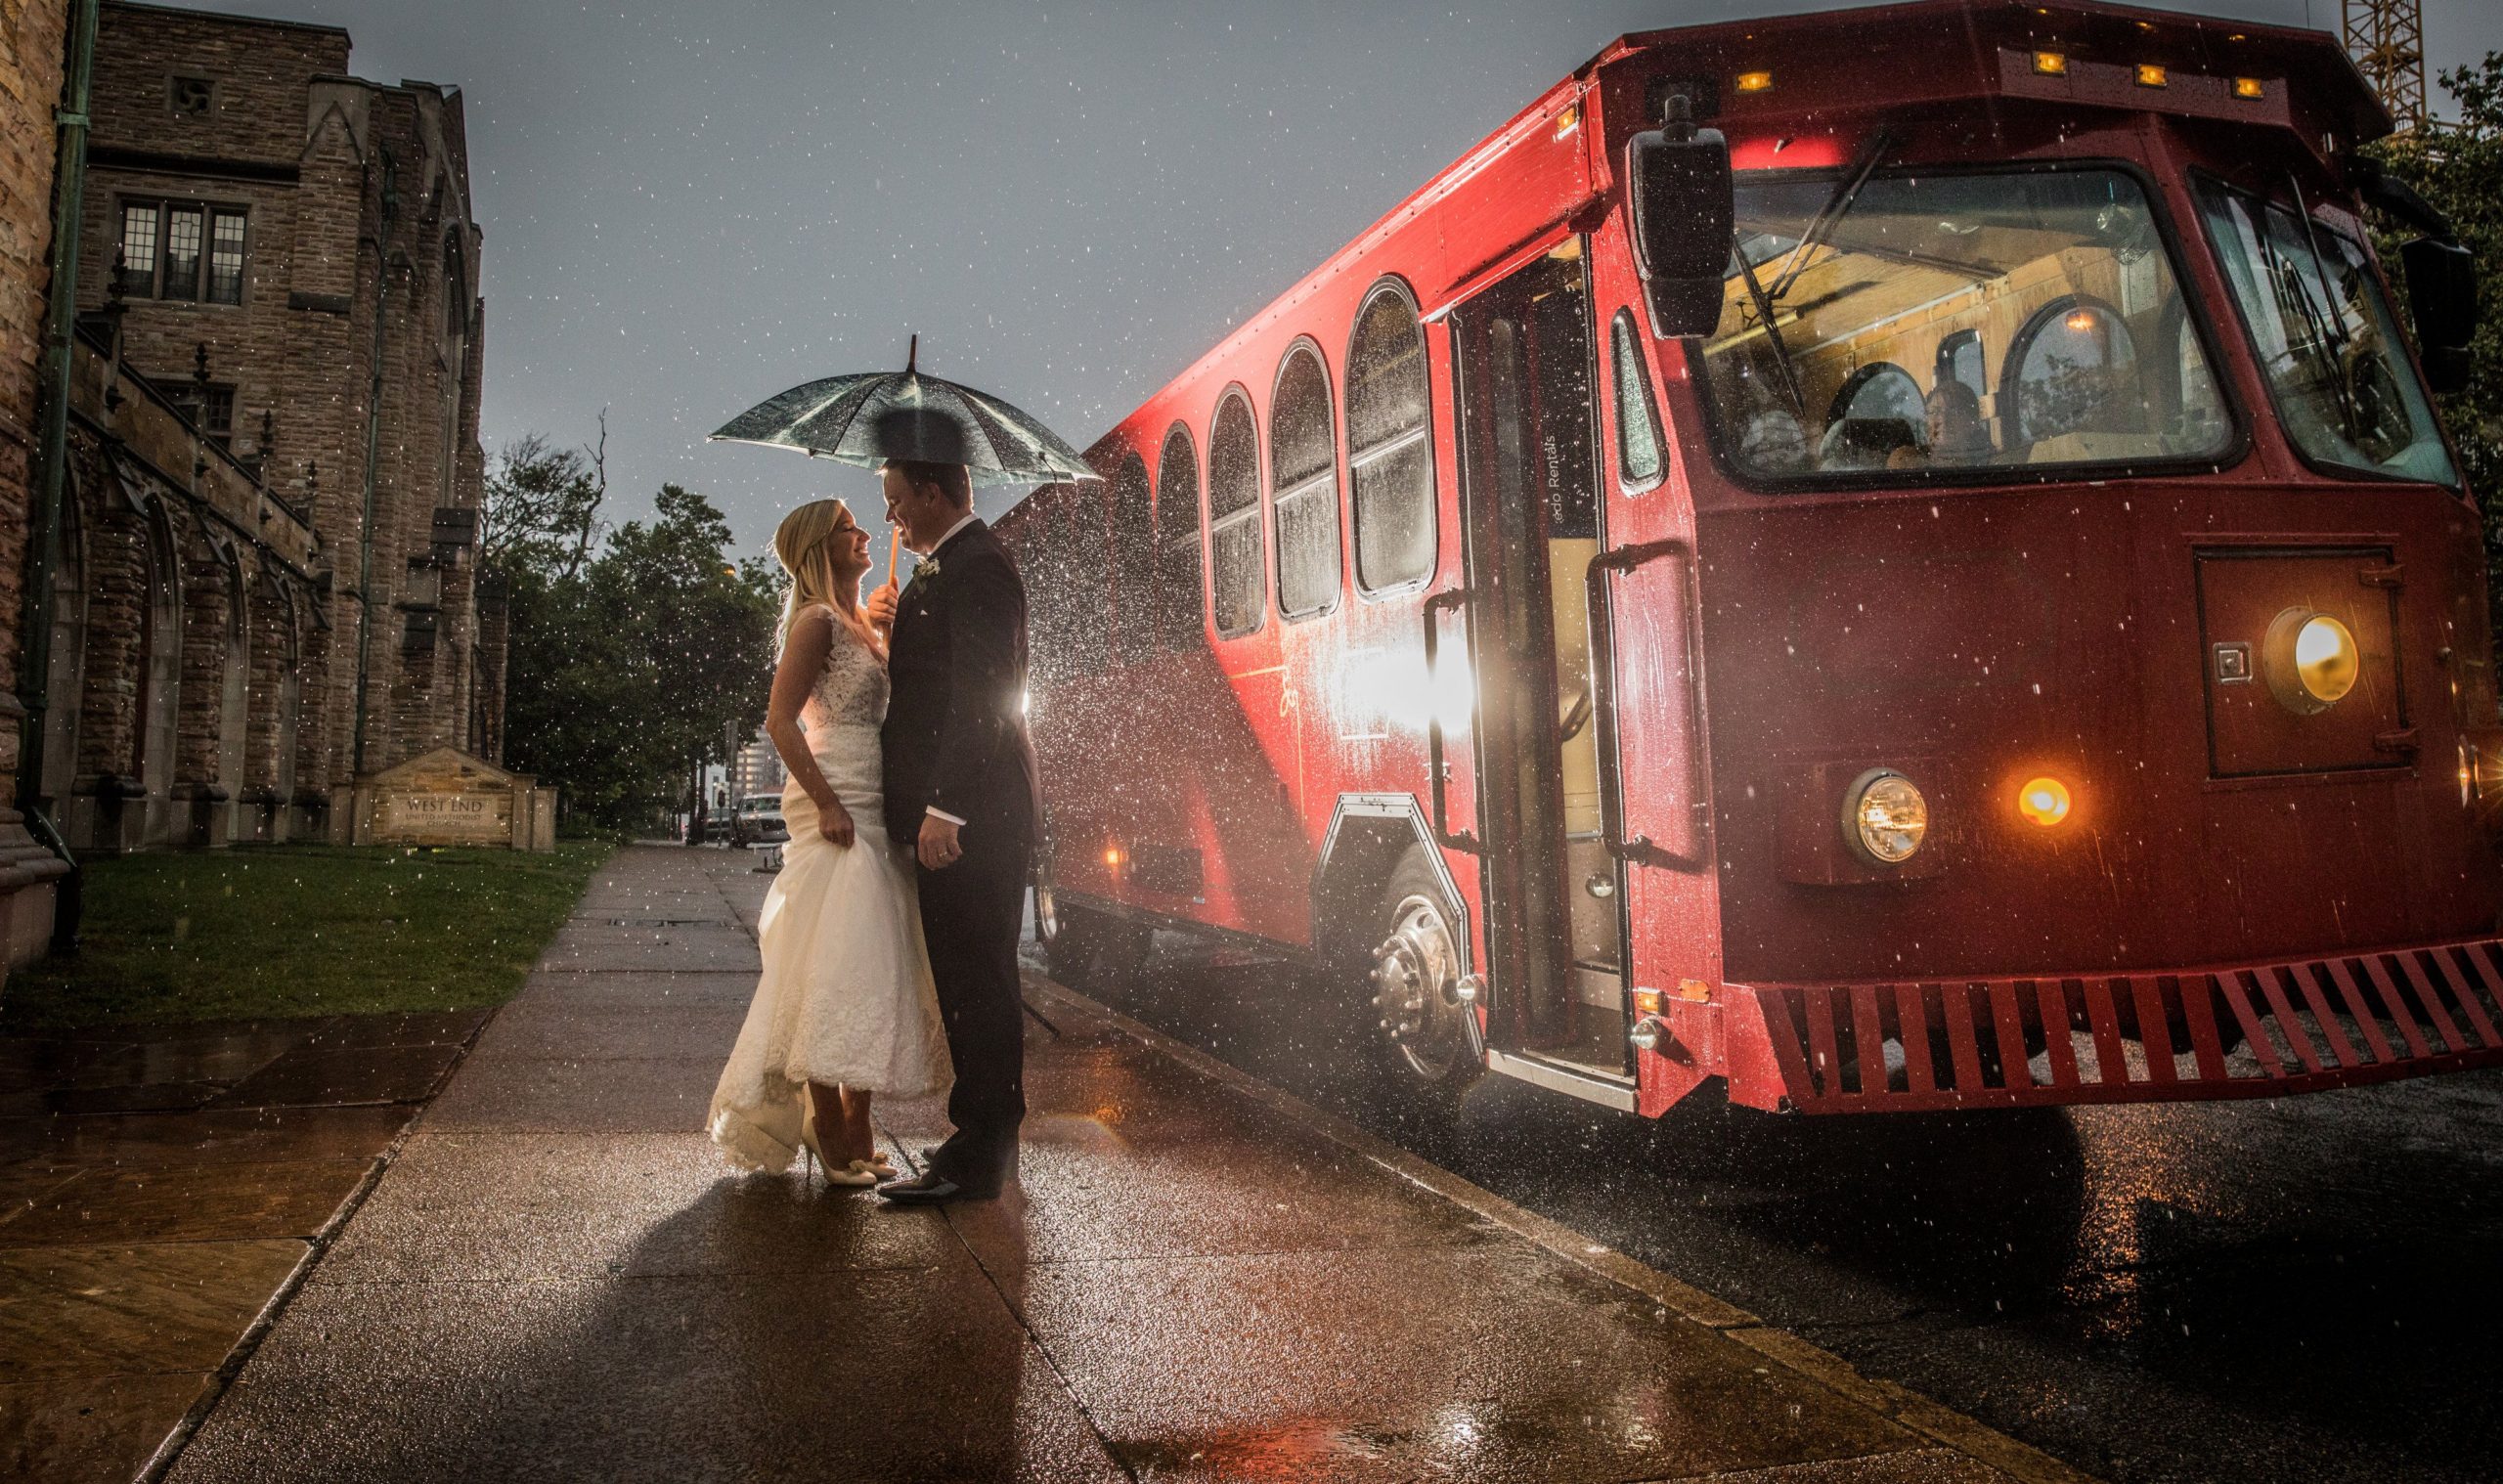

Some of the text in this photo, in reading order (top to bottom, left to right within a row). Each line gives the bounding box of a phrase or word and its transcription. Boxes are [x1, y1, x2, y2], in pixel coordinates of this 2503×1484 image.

[1544, 435, 1564, 523] edo Rentals
[407, 801, 482, 811] WEST END
